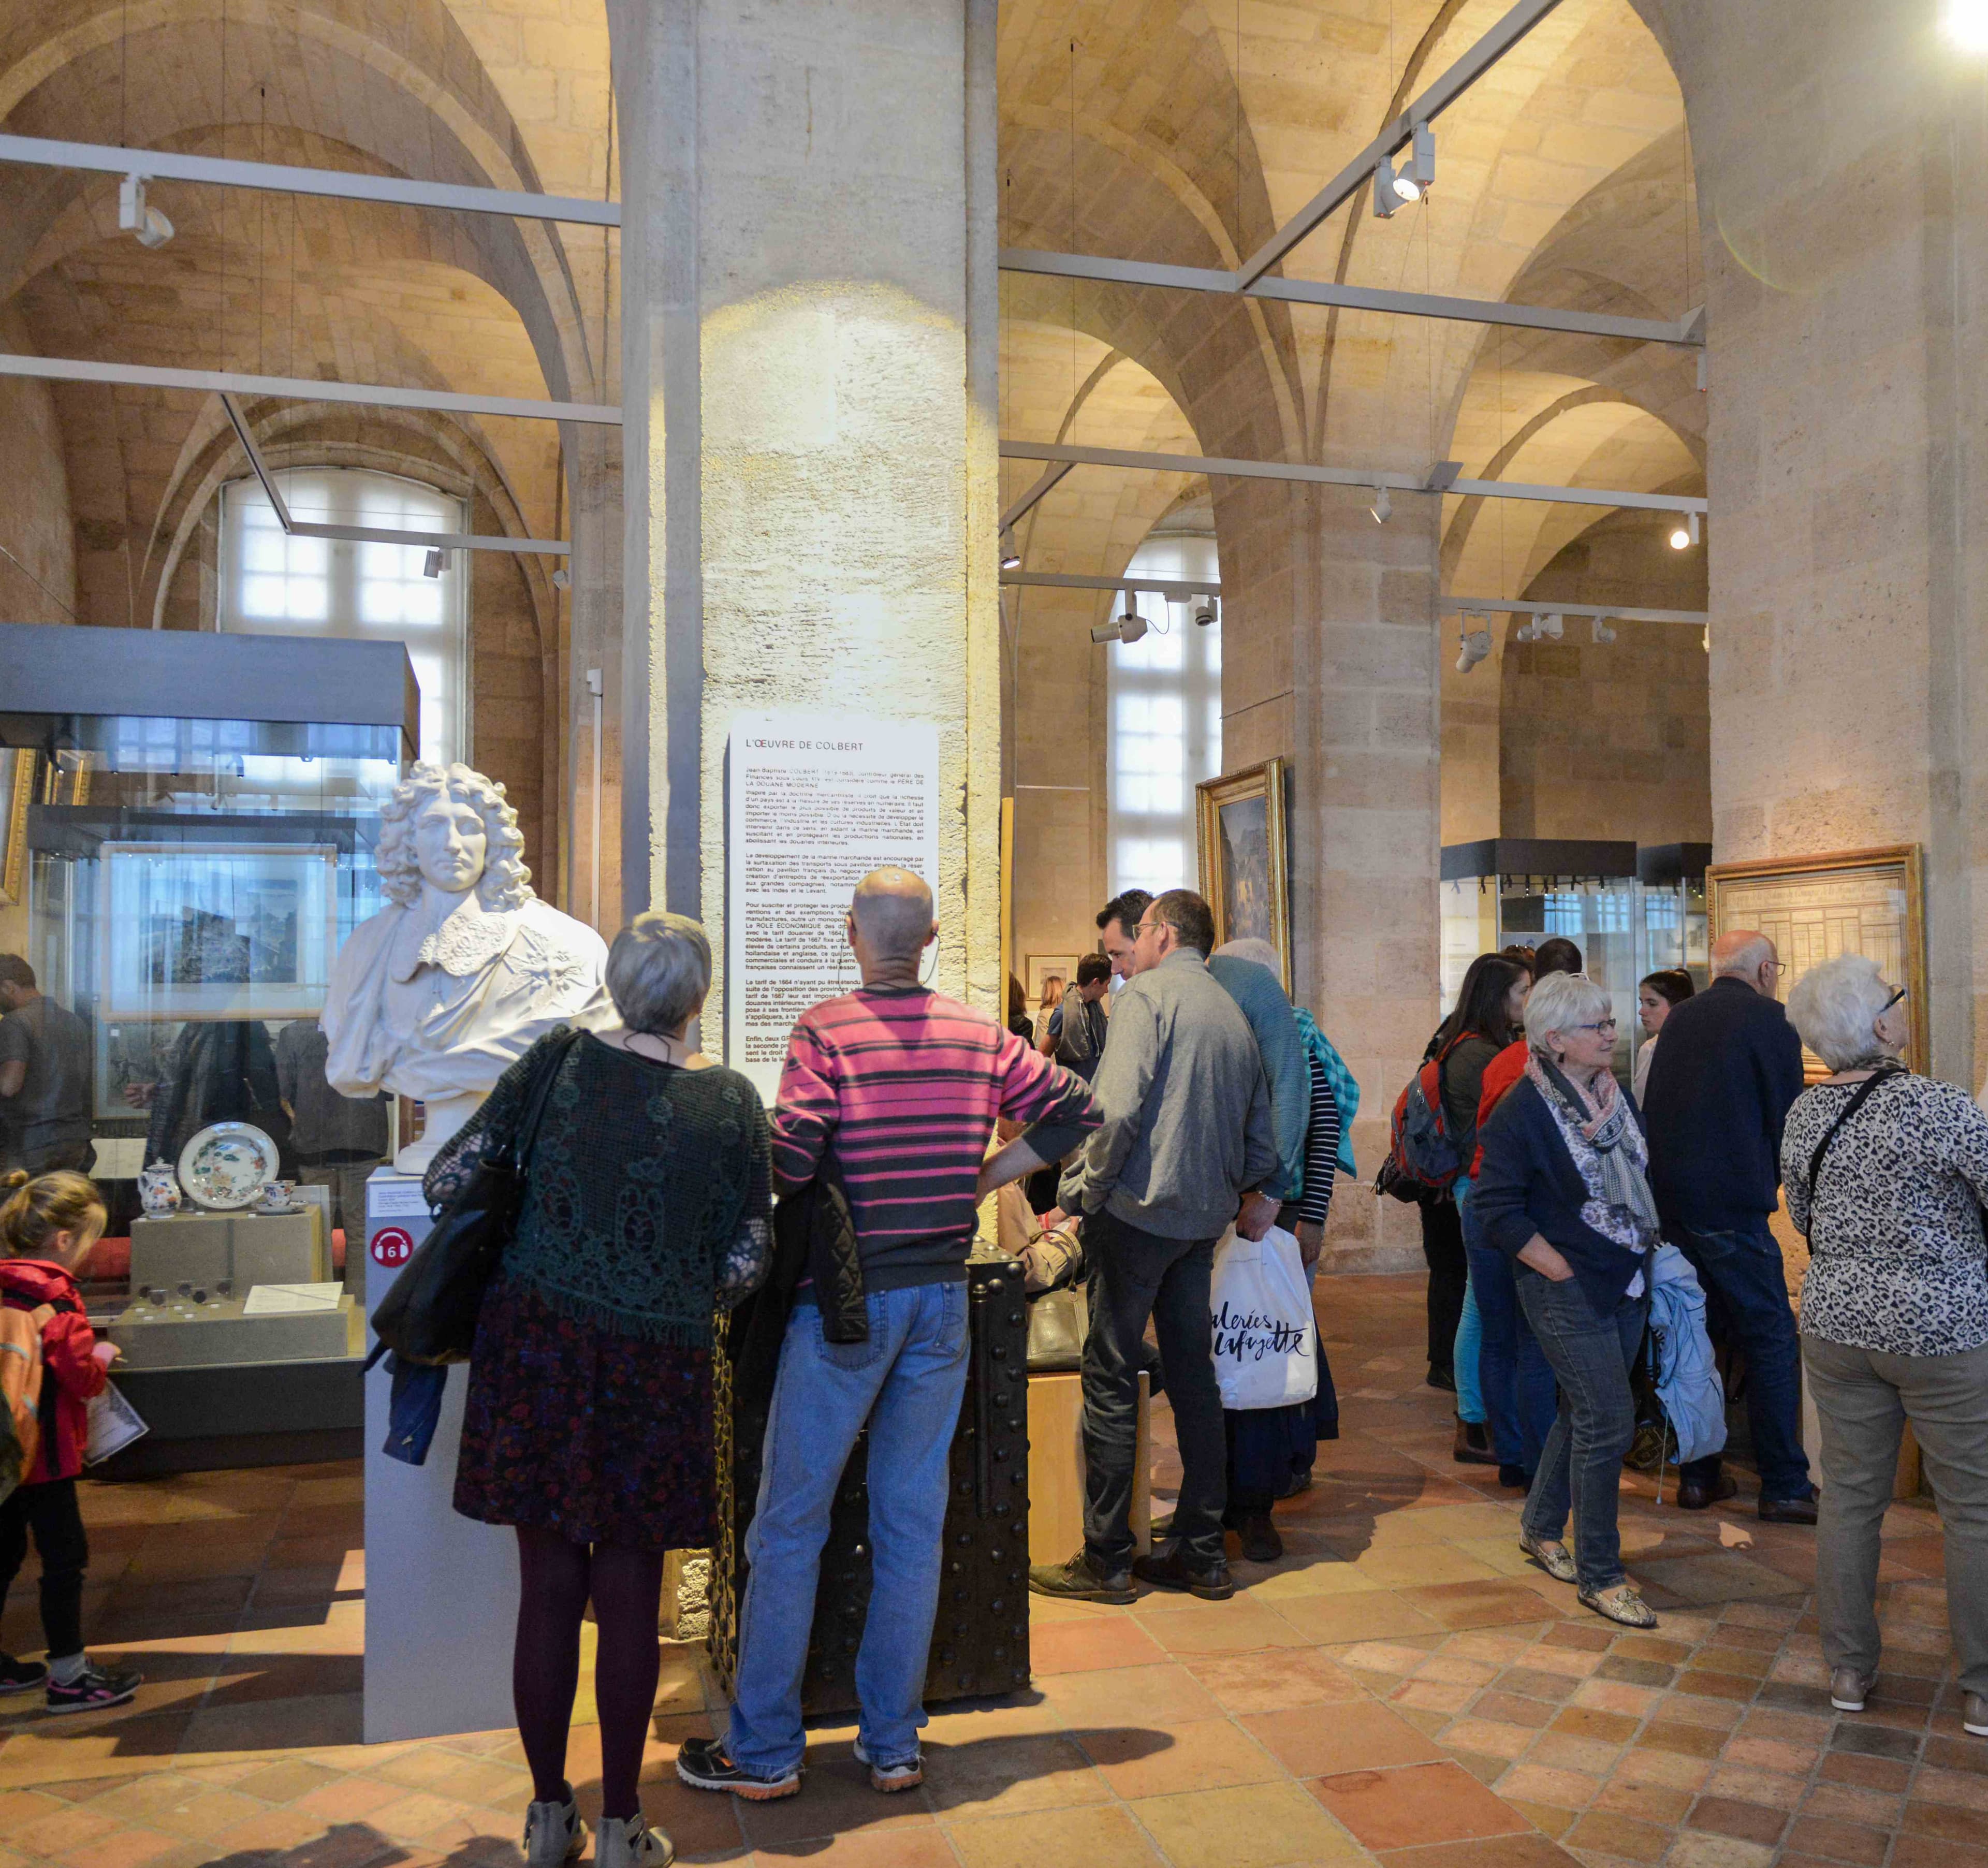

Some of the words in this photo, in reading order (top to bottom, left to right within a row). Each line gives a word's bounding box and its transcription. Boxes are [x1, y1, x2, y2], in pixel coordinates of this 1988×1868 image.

[746, 739, 795, 749] L'ŒUVRE
[799, 741, 812, 749] DE
[815, 741, 864, 751] COLBERT
[388, 1246, 397, 1258] 6
[1211, 1301, 1272, 1330] aleries
[1214, 1320, 1310, 1362] Lafayette
